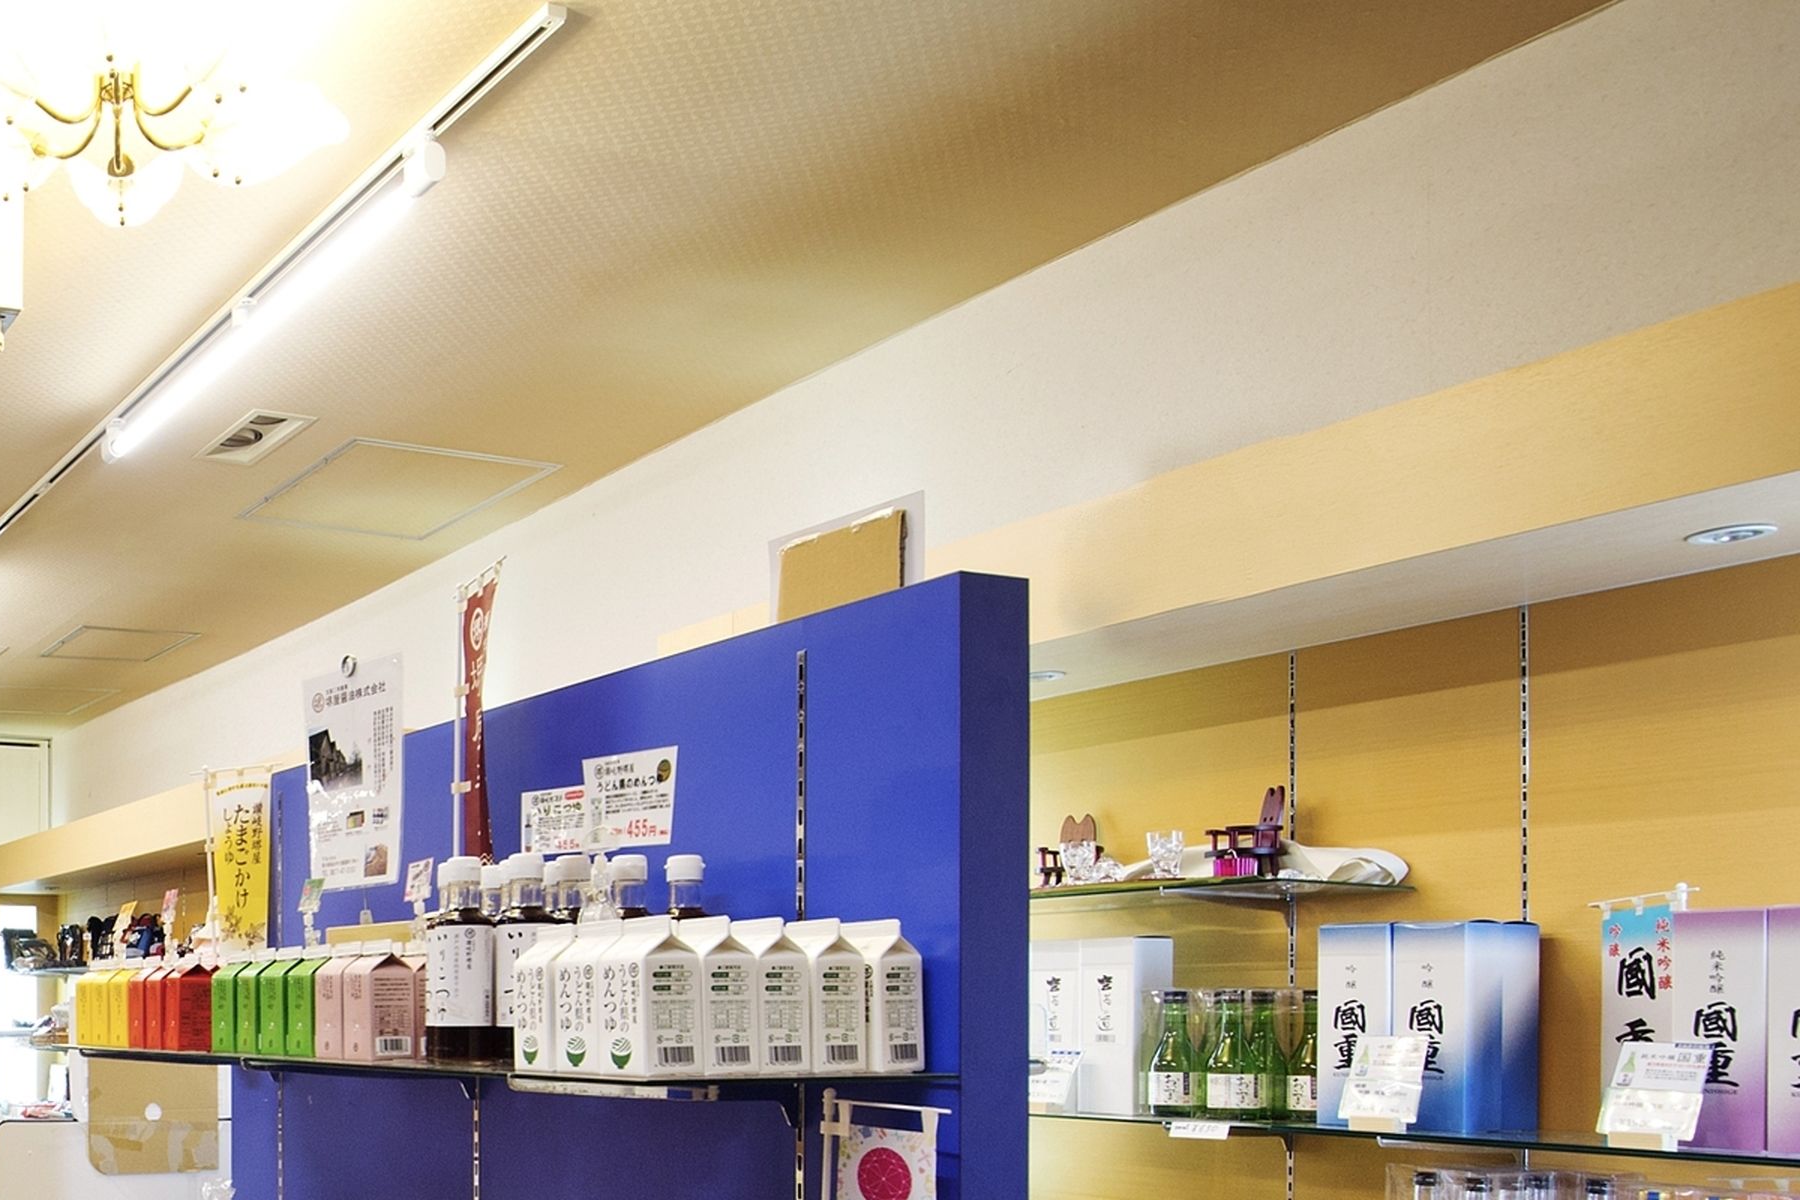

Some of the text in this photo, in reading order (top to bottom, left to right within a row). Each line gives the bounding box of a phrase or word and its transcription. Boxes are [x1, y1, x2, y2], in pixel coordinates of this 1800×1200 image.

[597, 776, 657, 792] うどん県のめんつ
[222, 807, 234, 866] しょうゆ
[234, 804, 250, 909] たまごかけ
[516, 967, 528, 1033] めんつゆ
[559, 966, 573, 1033] めんつゆ
[603, 965, 618, 1033] めんつゆ
[1694, 1002, 1740, 1087] 國重
